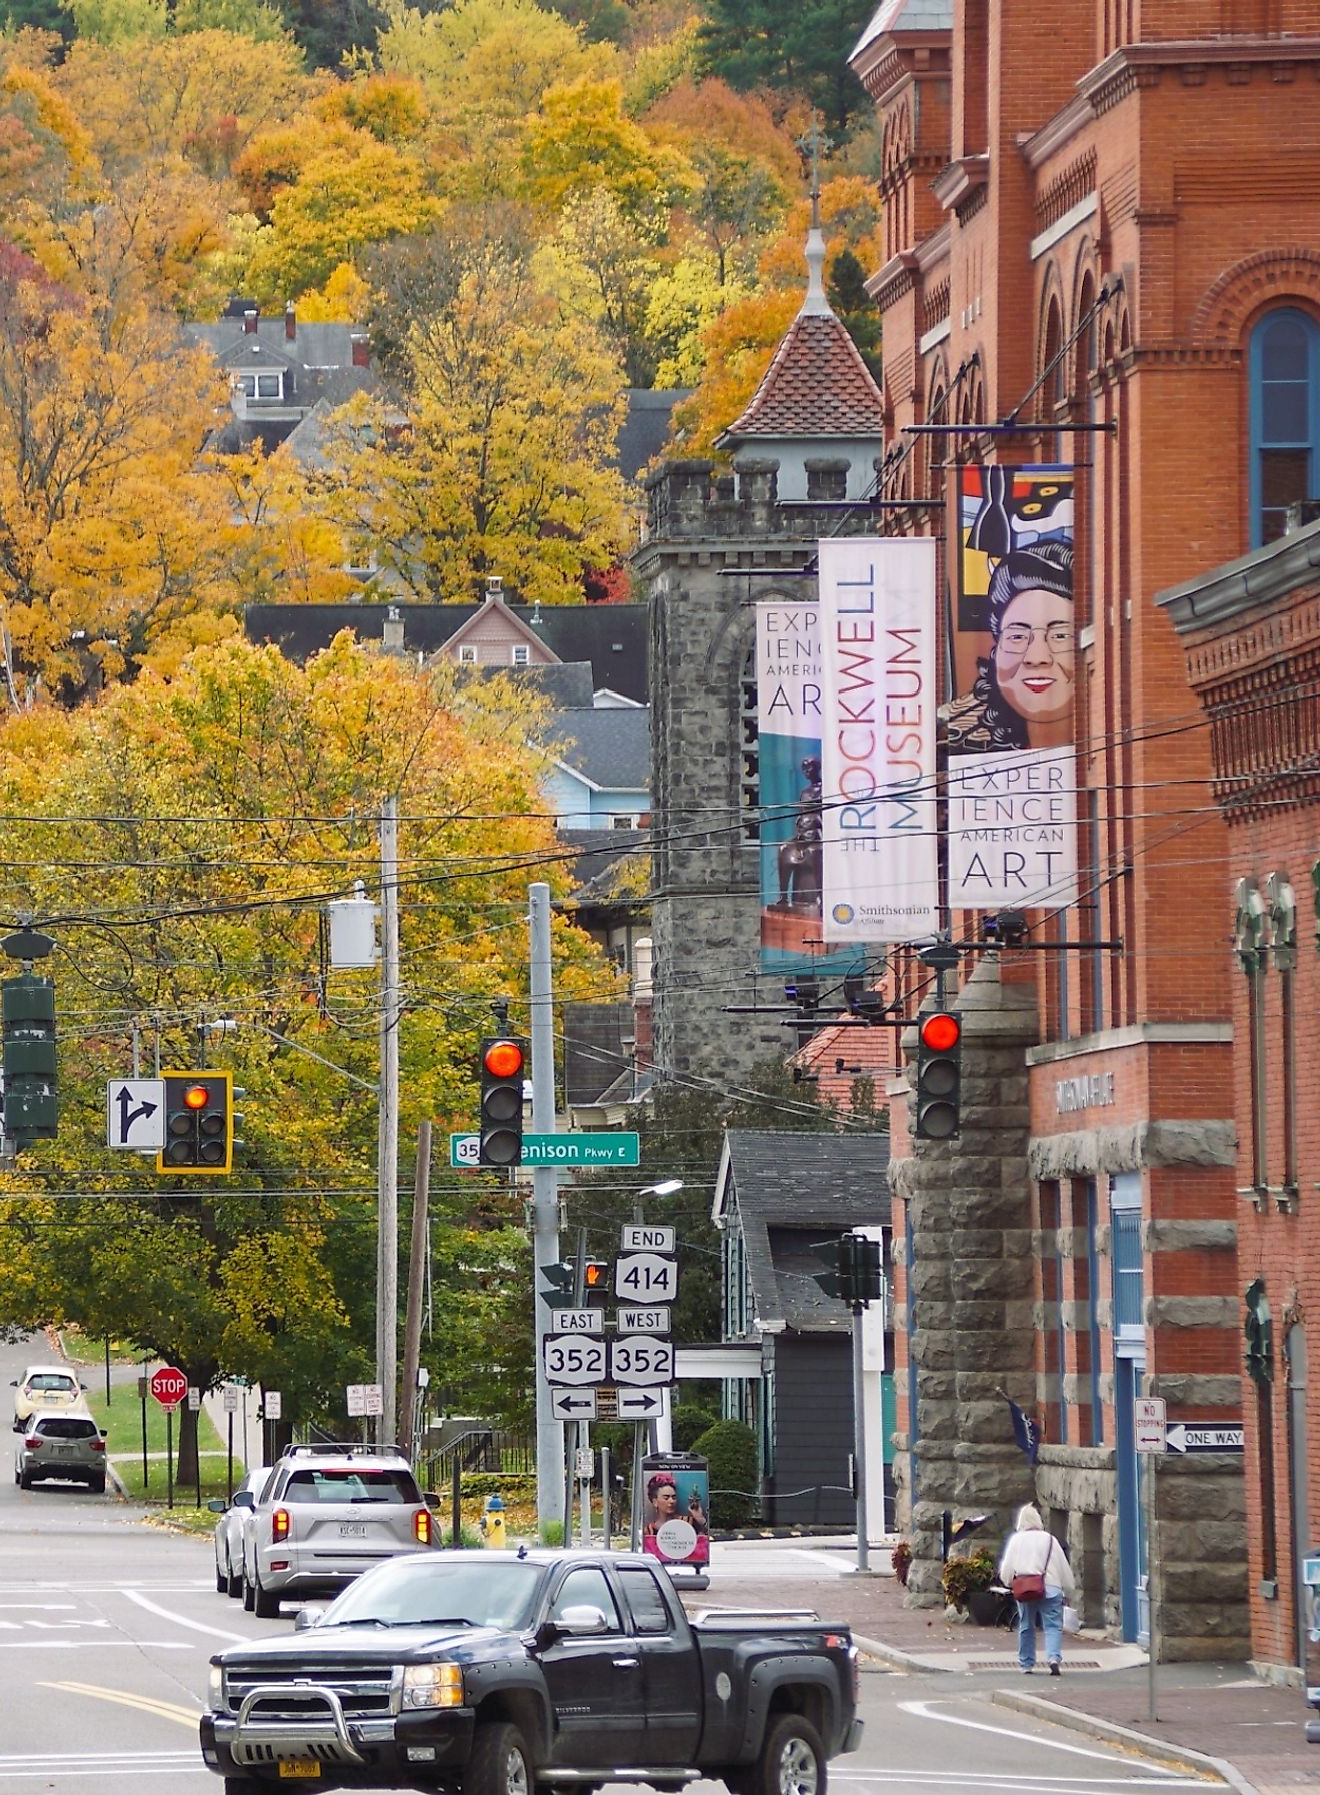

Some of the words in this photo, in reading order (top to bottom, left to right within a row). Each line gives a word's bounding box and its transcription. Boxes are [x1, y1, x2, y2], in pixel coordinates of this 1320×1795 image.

[766, 612, 818, 632] EXP
[766, 638, 821, 659] IEN
[766, 664, 821, 676] AMERI
[767, 683, 821, 715] AR
[837, 563, 877, 830] ROCKWELL
[885, 628, 923, 830] MUSEUM
[961, 766, 1063, 790] EXPER
[961, 798, 1063, 821] IENCE
[960, 828, 1064, 842] AMERICAN
[961, 851, 1063, 888] ART
[859, 904, 930, 916] Smithsonian
[459, 1143, 480, 1159] 35
[520, 1141, 579, 1159] enison
[584, 1147, 613, 1158] Pkwy
[617, 1147, 626, 1157] E
[632, 1231, 665, 1246] END
[623, 1266, 669, 1290] 414
[560, 1314, 594, 1329] EAST
[625, 1313, 662, 1328] WEST
[549, 1348, 602, 1372] 352
[615, 1348, 670, 1373] 352
[152, 1379, 185, 1393] STOP
[1144, 1405, 1156, 1417] NO
[1136, 1419, 1165, 1428] STOPPING
[1185, 1432, 1211, 1444] ONE
[1215, 1432, 1241, 1444] WAY
